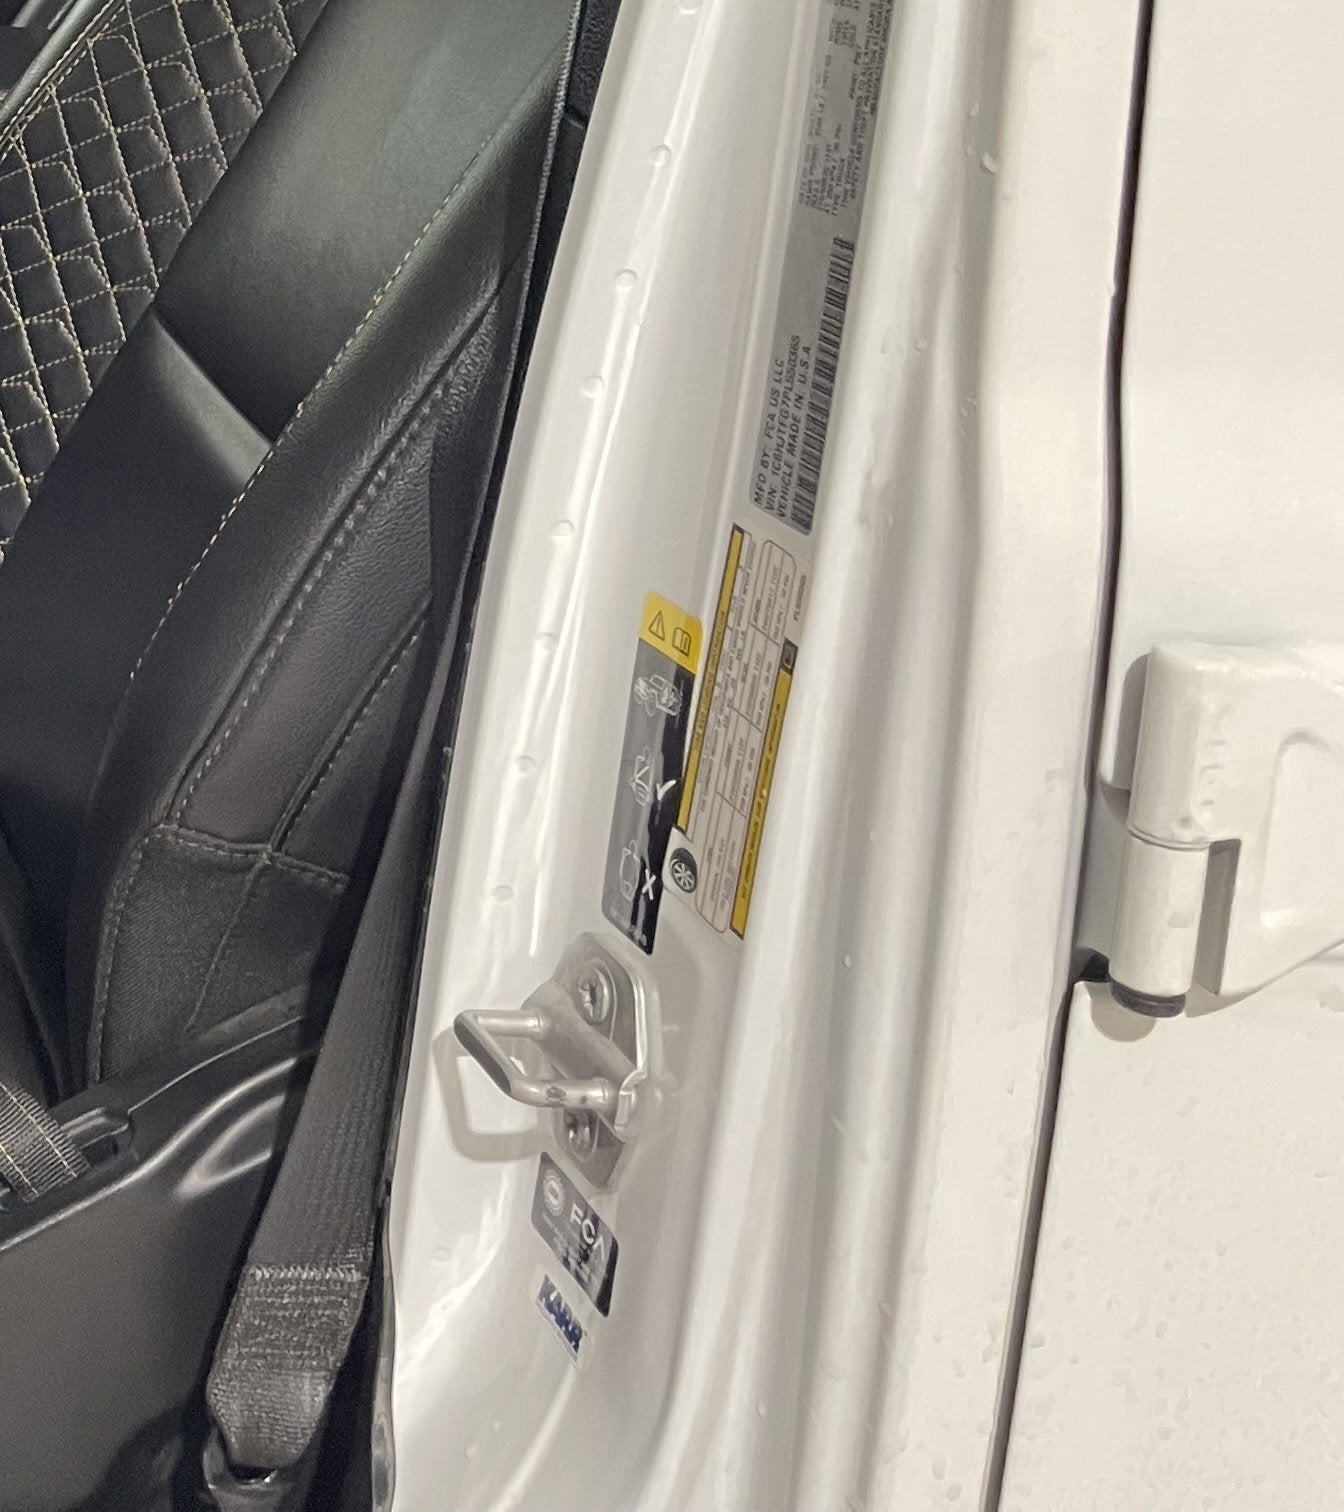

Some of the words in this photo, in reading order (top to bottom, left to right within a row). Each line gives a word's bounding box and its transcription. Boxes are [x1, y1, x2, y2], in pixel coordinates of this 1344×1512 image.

[773, 357, 785, 384] LLC
[769, 387, 781, 407] US
[793, 393, 804, 410] IN
[764, 411, 777, 439] FCA
[786, 414, 802, 457] MADE
[754, 472, 767, 505] MFD
[776, 461, 794, 518] VEHICLE
